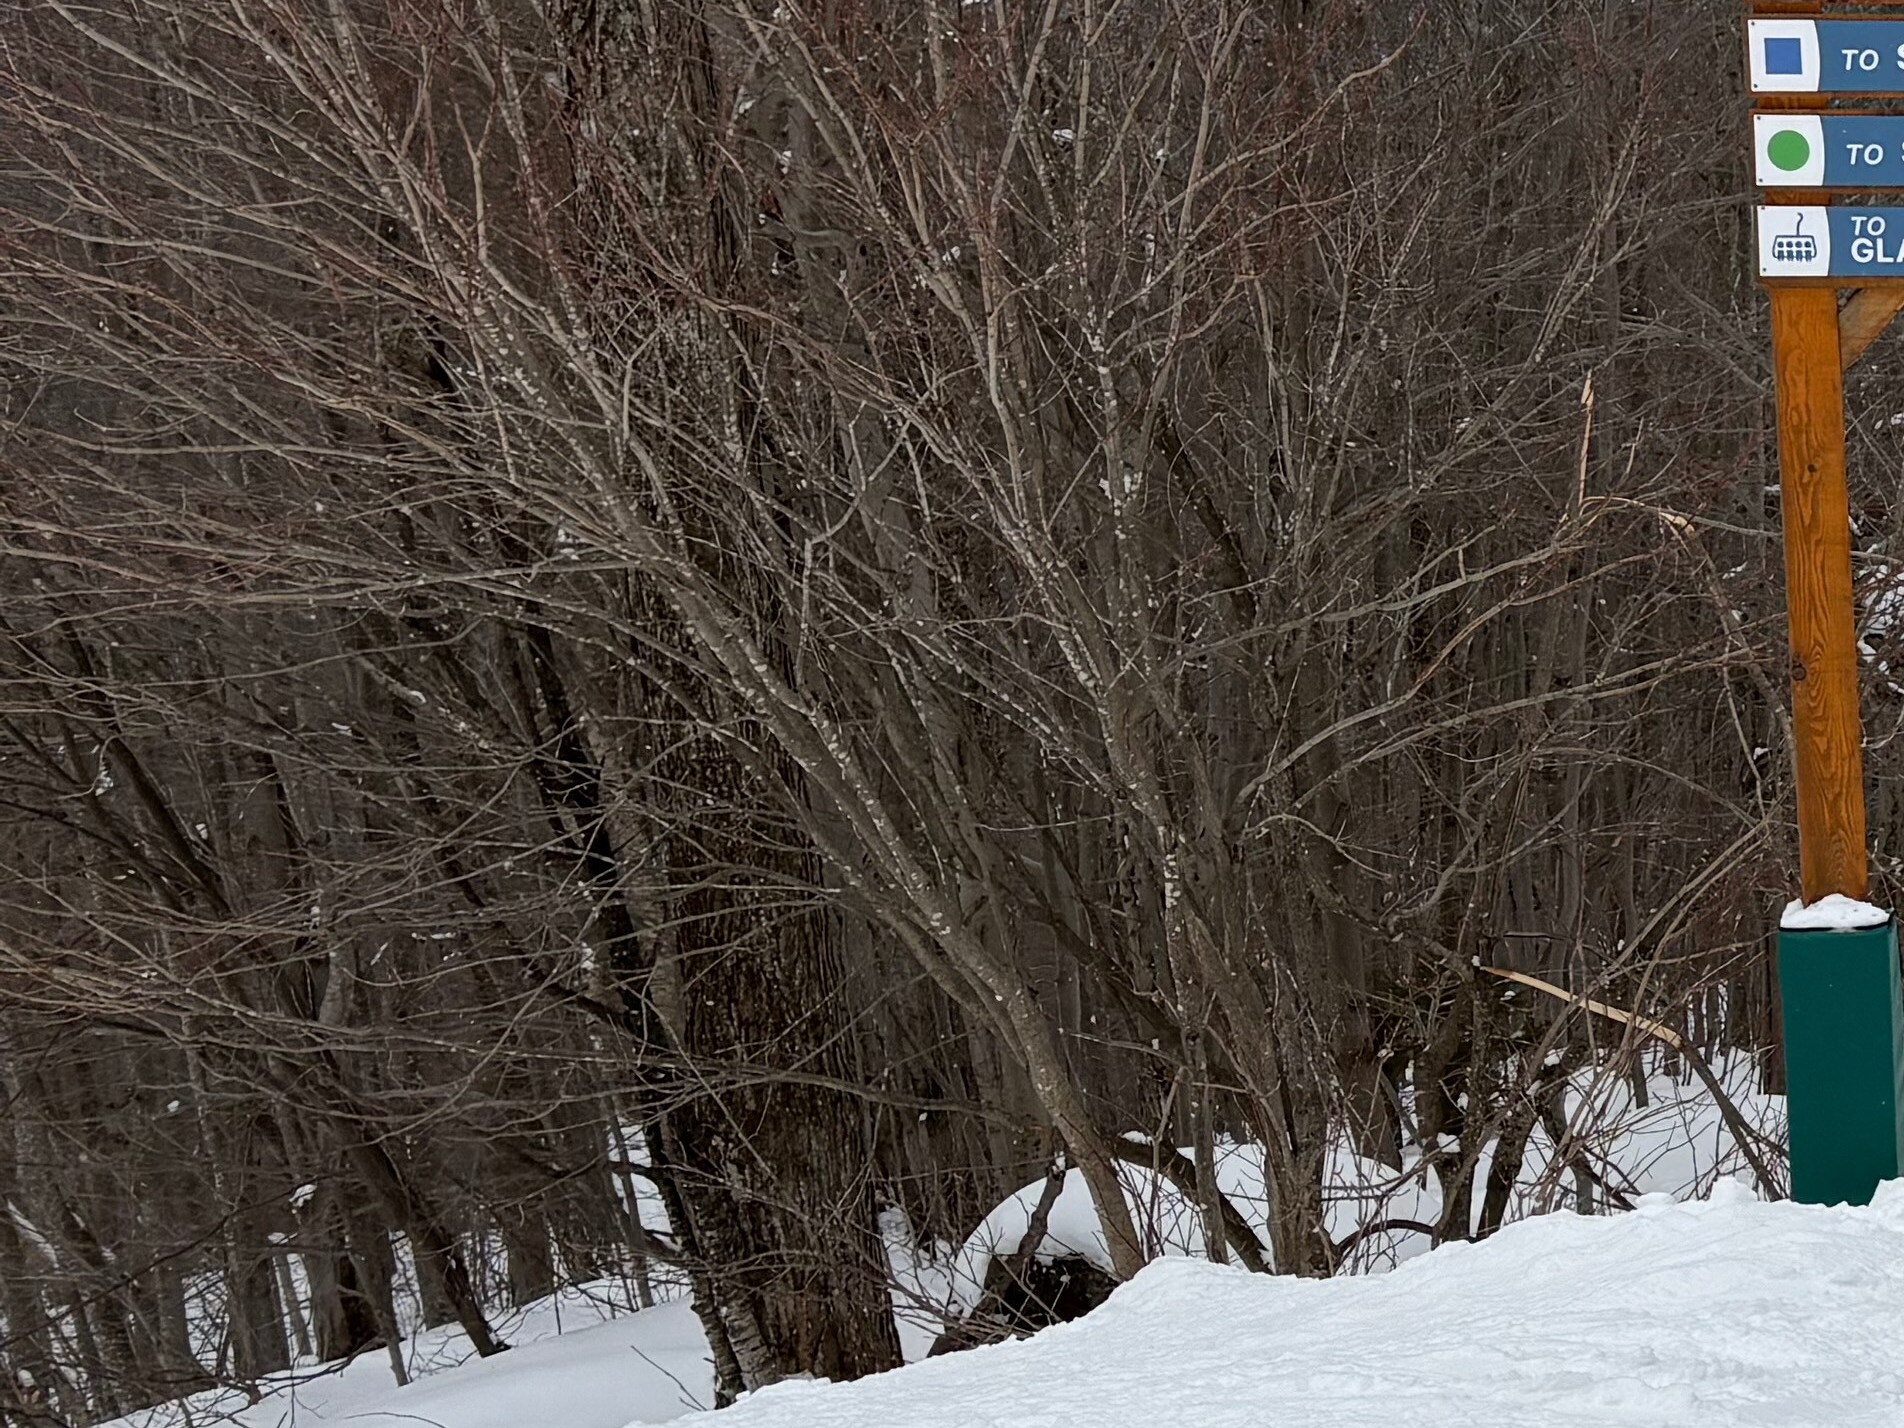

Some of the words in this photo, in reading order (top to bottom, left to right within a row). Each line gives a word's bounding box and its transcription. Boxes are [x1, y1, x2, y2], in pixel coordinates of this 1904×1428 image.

[1841, 49, 1879, 71] TO
[1846, 143, 1884, 165] TO
[1850, 216, 1886, 236] TO
